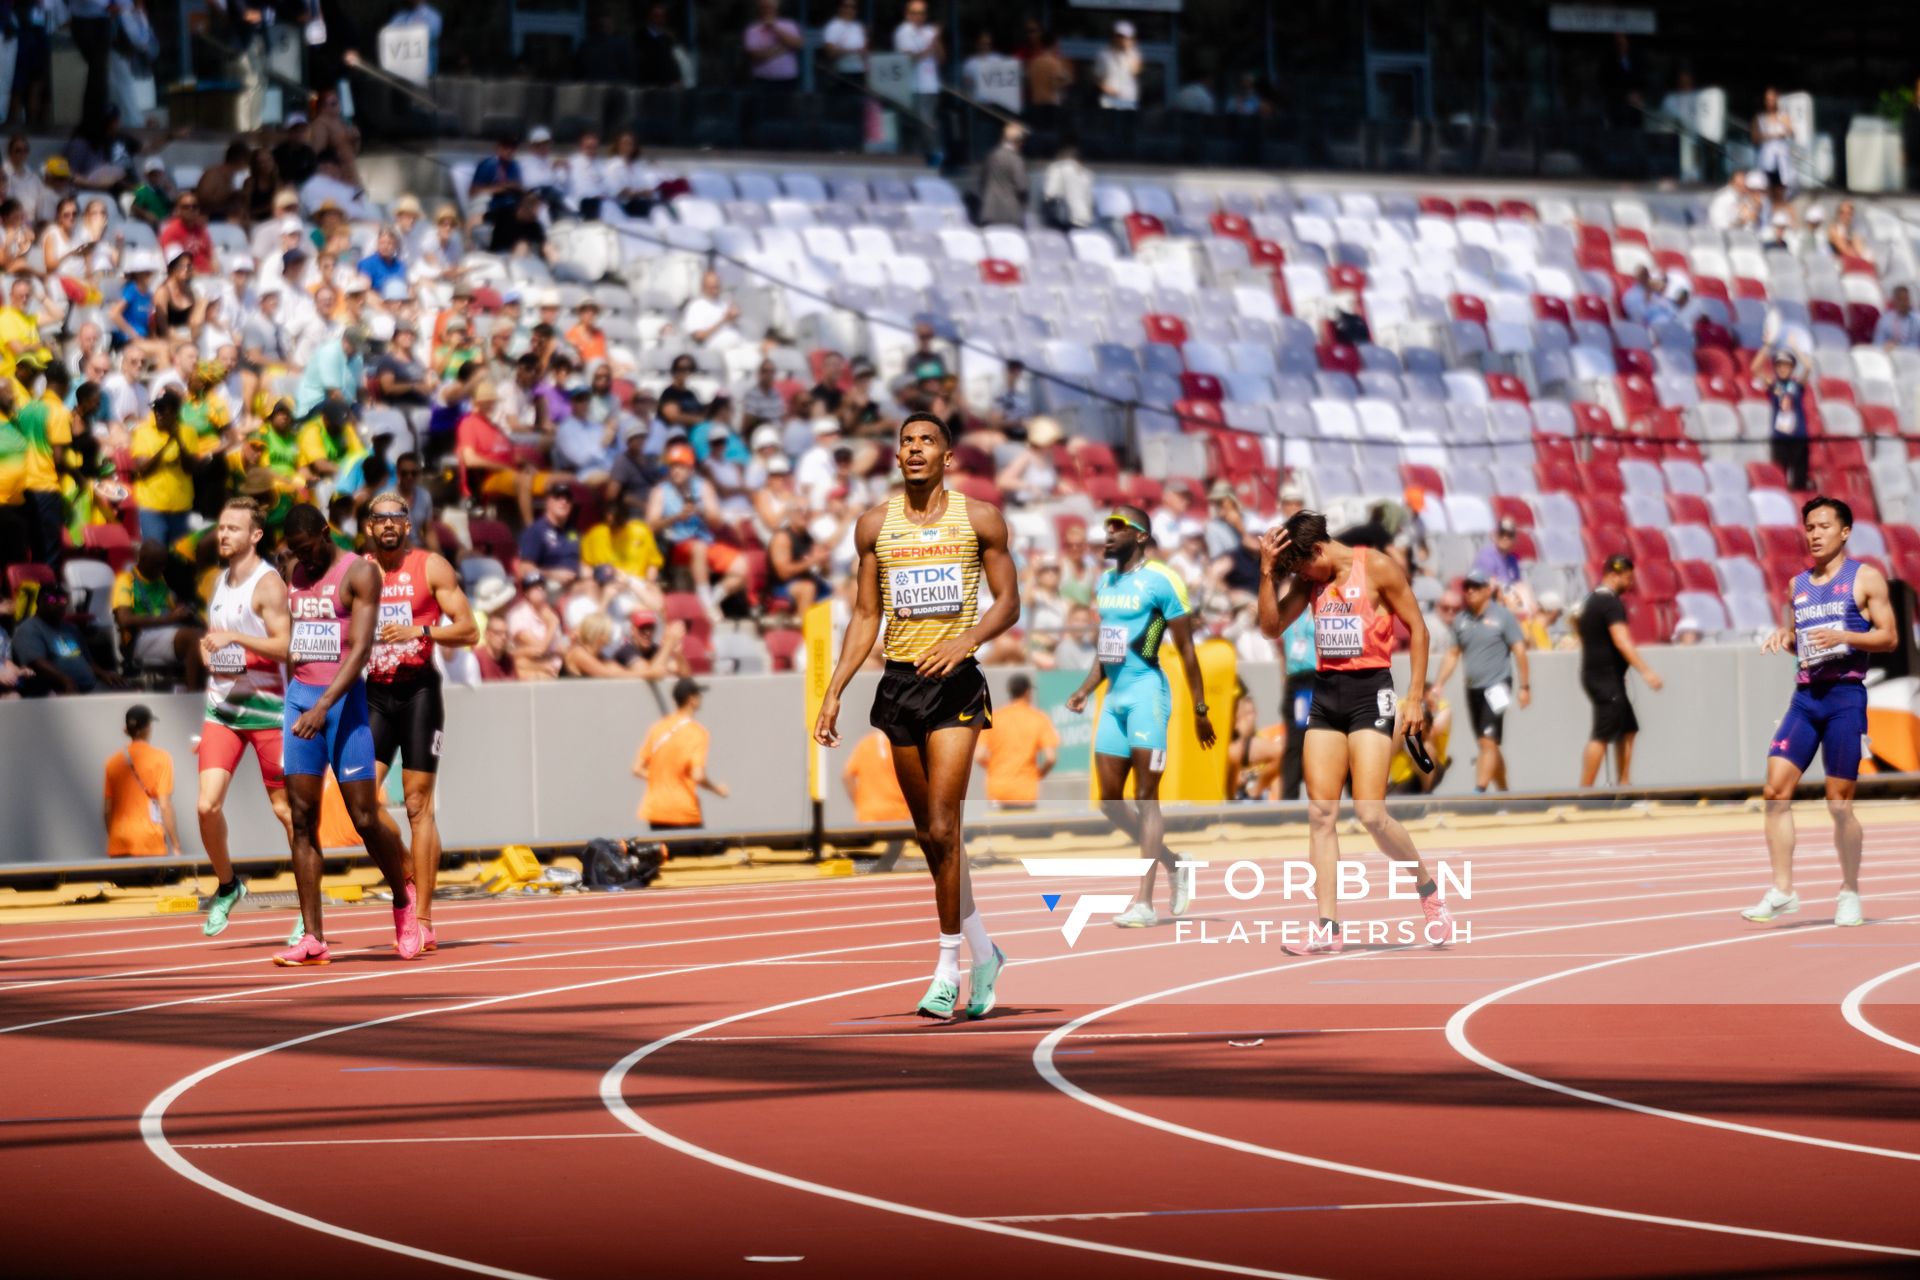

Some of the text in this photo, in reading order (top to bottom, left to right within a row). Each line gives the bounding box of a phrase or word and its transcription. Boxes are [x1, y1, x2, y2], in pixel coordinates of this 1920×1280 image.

[388, 42, 423, 60] V11
[891, 545, 961, 557] GERMANY
[908, 566, 957, 584] TDK
[895, 585, 959, 605] AGYEKUM
[288, 597, 337, 618] USA
[913, 606, 950, 614] BUDAPEST
[1320, 602, 1352, 613] JAPAN
[1795, 602, 1845, 623] SINGAPORE
[306, 624, 335, 636] TDK
[1320, 617, 1358, 630] TDK
[293, 639, 338, 652] BENJAMIN
[1385, 693, 1393, 712] 3
